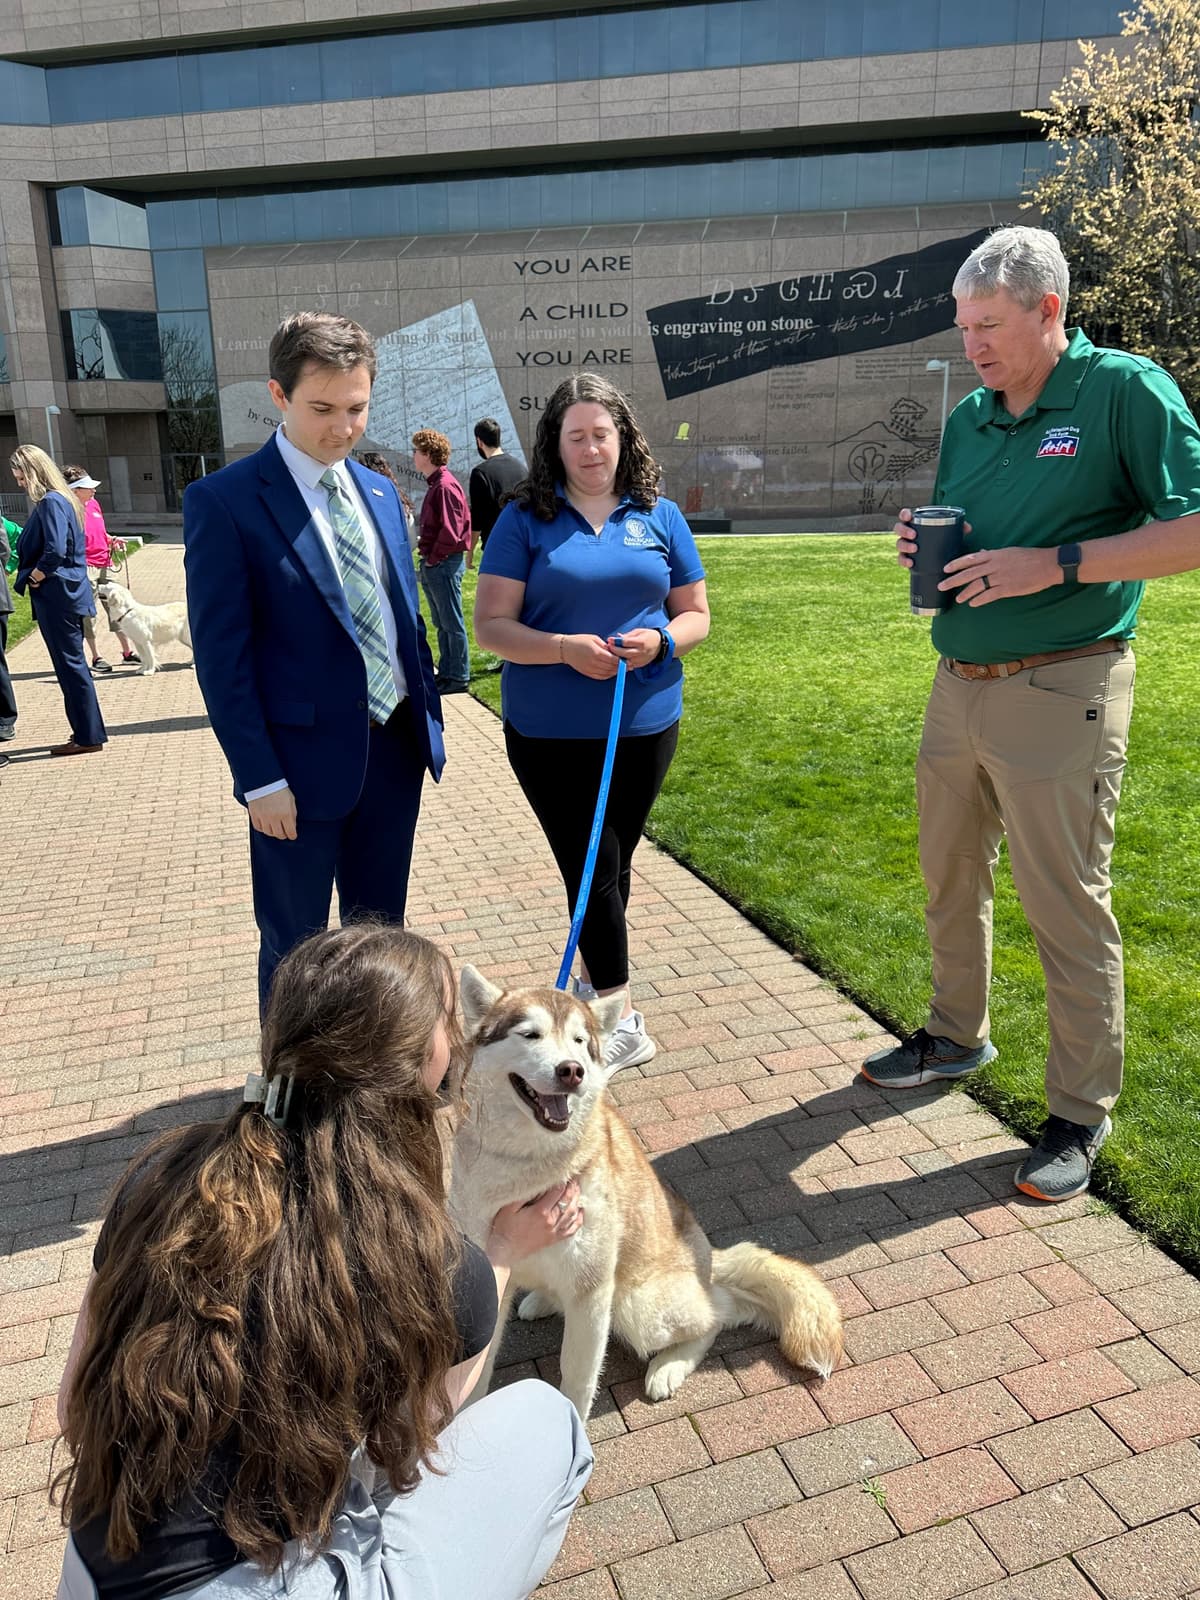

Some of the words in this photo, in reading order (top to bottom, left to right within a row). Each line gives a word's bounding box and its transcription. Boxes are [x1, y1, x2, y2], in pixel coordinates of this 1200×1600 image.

[513, 258, 570, 275] YOU
[580, 255, 632, 273] ARE
[519, 306, 538, 321] A
[546, 302, 628, 320] CHILD
[378, 331, 418, 345] riting
[422, 333, 440, 345] on
[514, 324, 576, 342] learning
[580, 324, 594, 338] in
[600, 323, 642, 341] youth
[648, 320, 660, 335] is
[663, 318, 743, 338] engraving
[747, 320, 767, 332] on
[771, 316, 813, 331] stone
[516, 351, 572, 366] YOU
[582, 348, 632, 364] ARE
[247, 408, 260, 424] by
